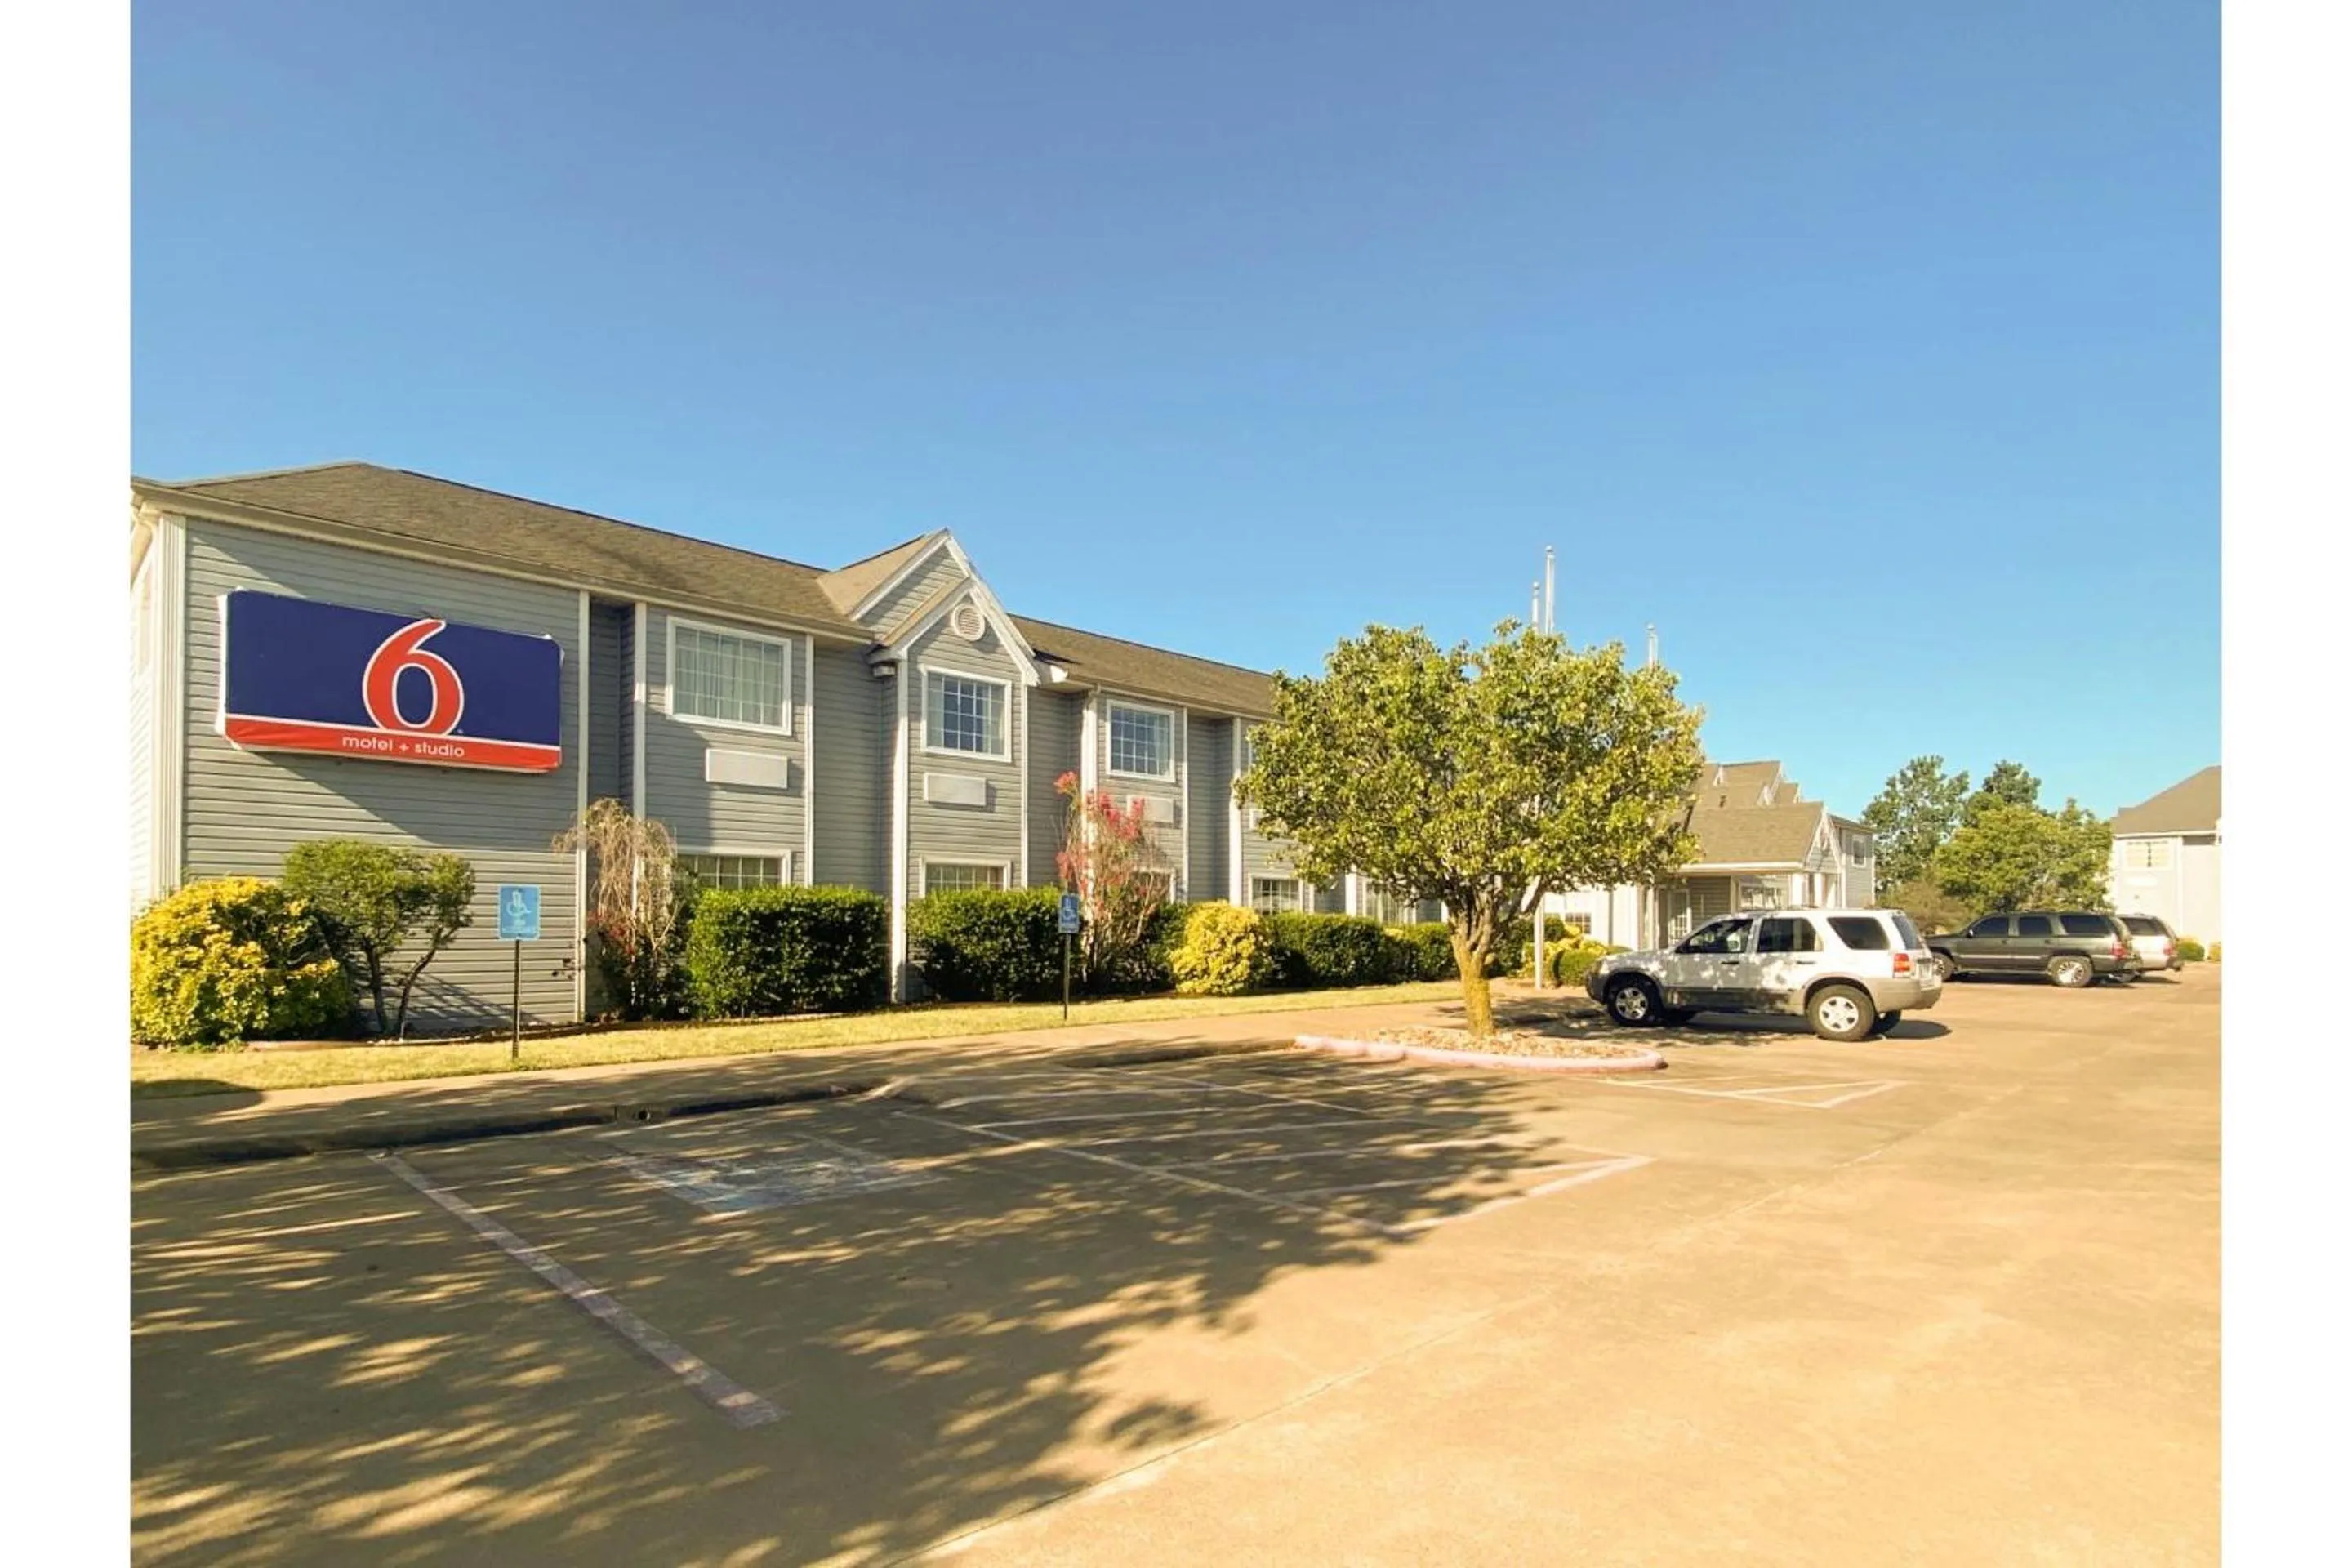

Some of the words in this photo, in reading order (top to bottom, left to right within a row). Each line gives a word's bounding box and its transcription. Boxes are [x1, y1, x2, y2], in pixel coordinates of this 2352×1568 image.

[362, 618, 465, 735] 6
[342, 737, 392, 751] motel
[415, 742, 465, 757] studio
